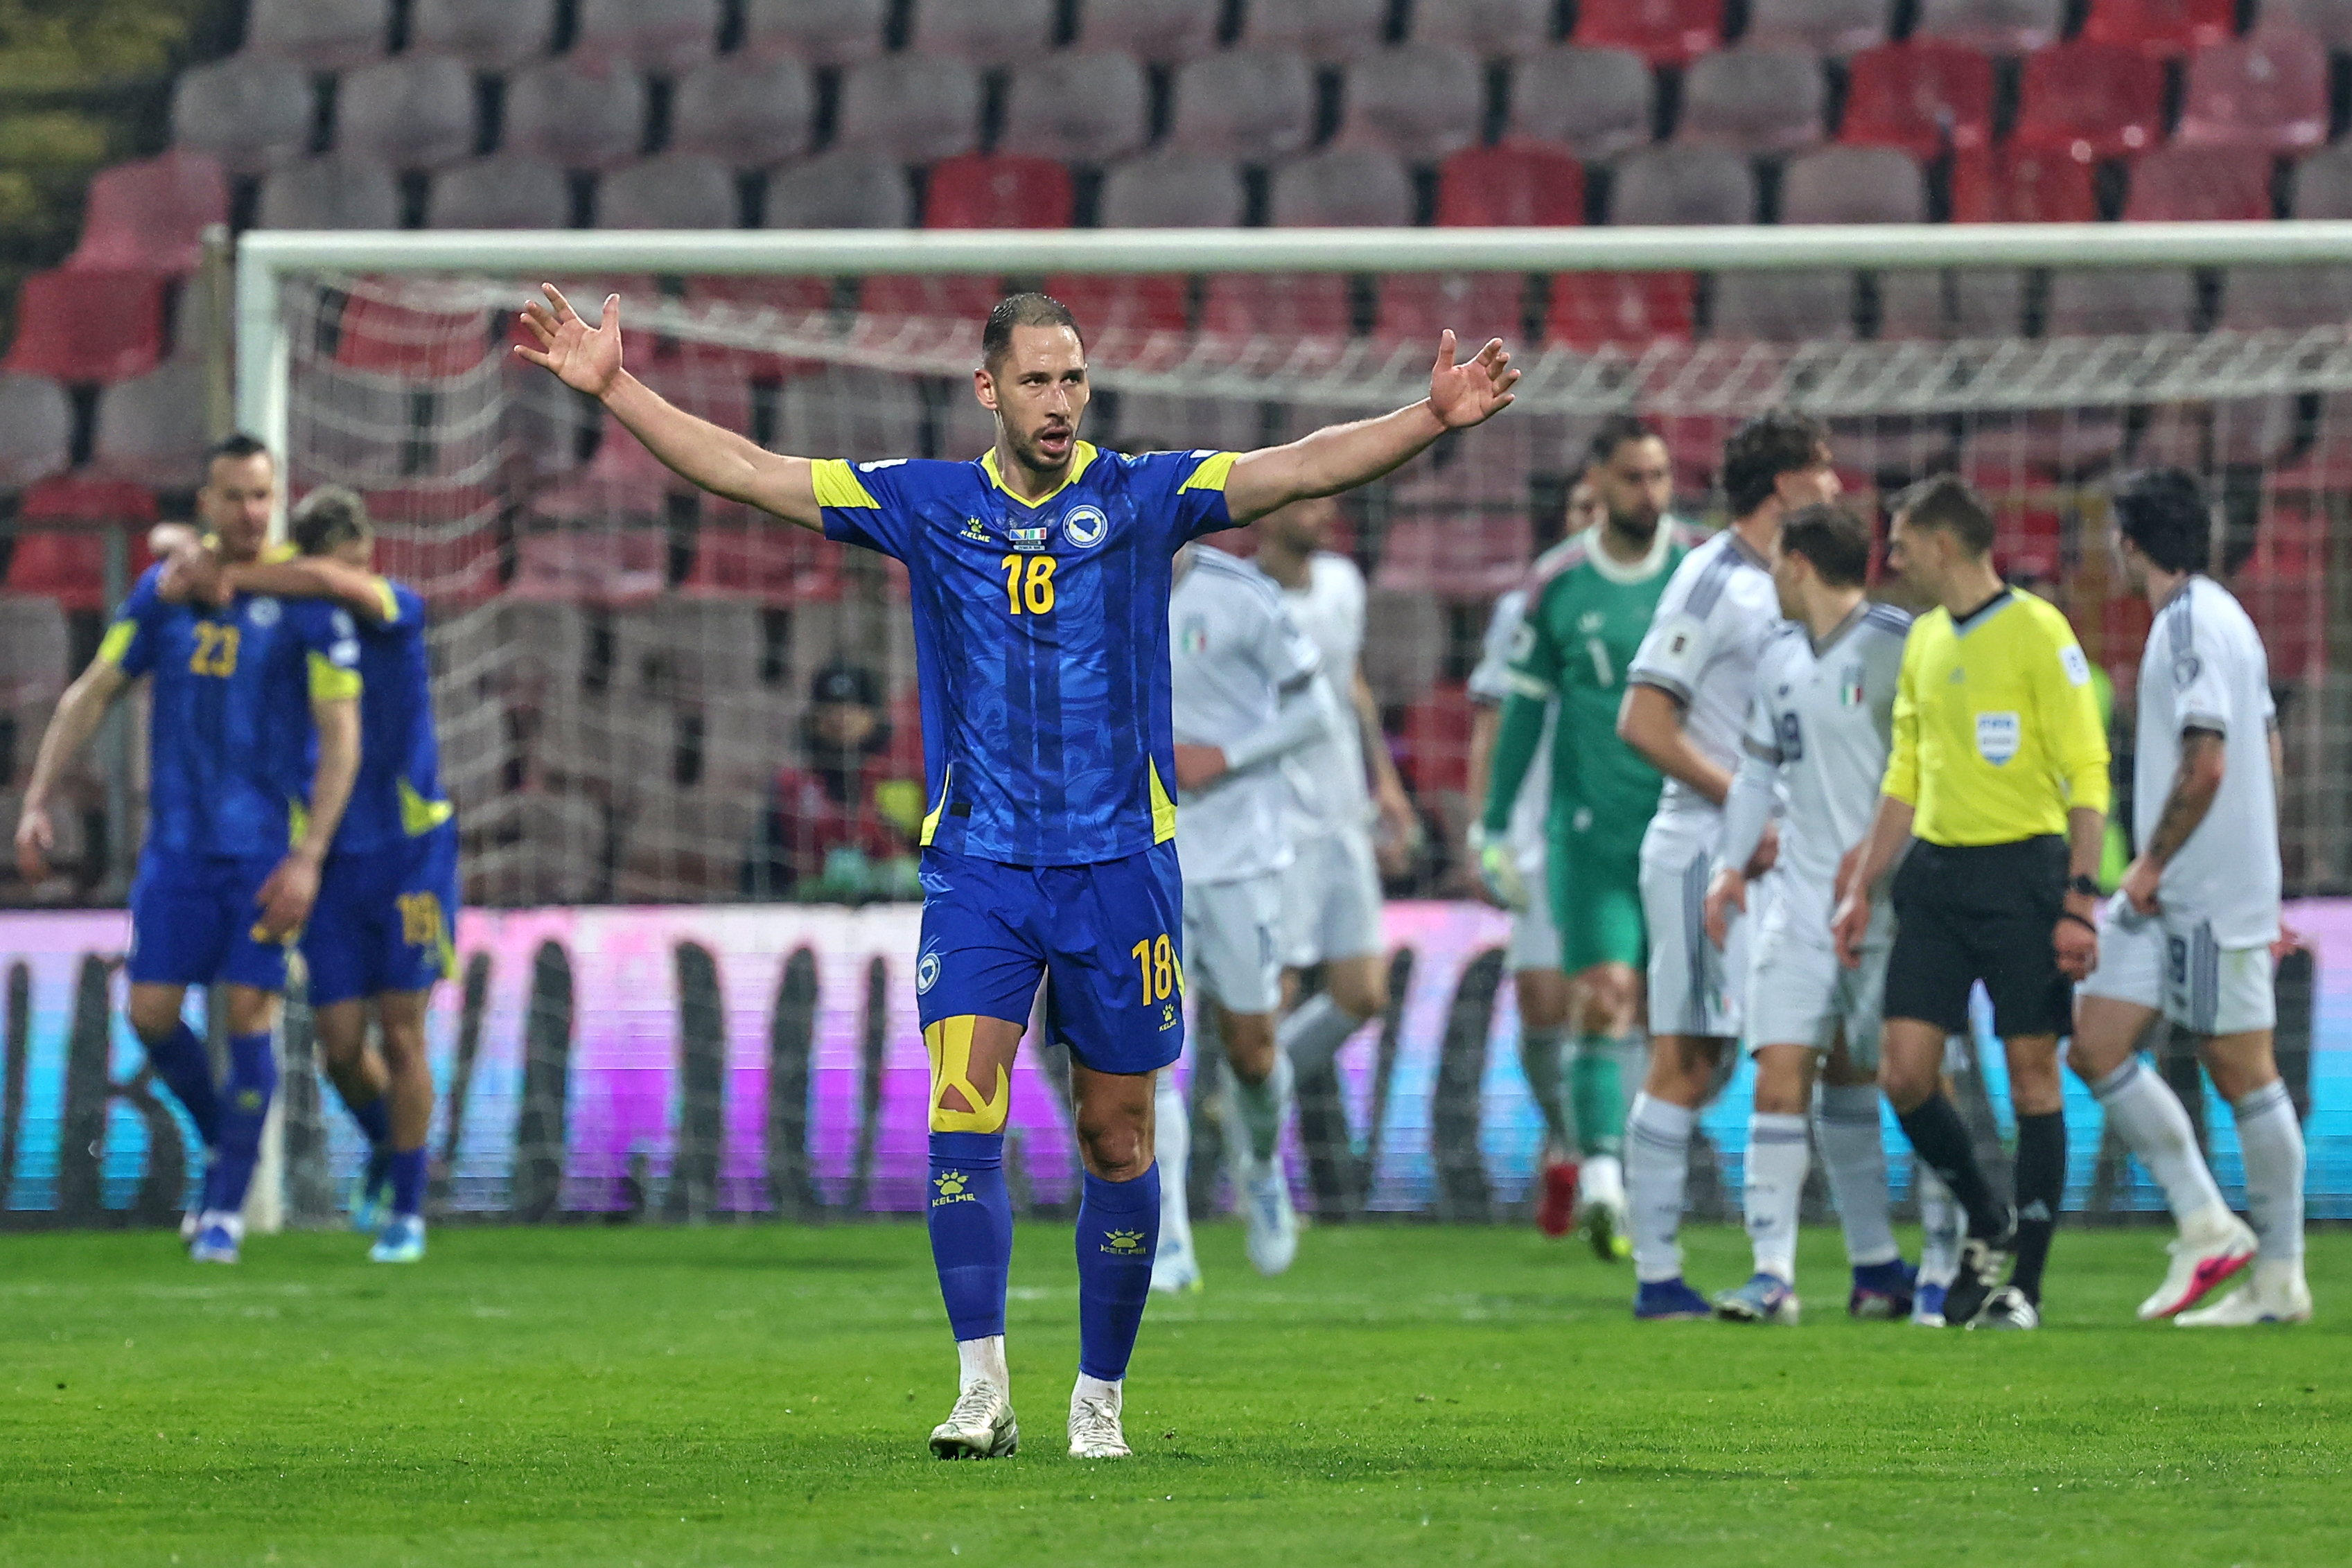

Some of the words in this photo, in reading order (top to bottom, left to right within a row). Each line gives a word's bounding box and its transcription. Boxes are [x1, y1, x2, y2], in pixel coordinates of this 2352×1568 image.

[960, 529, 991, 543] KELME
[1001, 554, 1057, 615] 18
[1132, 933, 1173, 1007] 18
[932, 1192, 976, 1208] KELME
